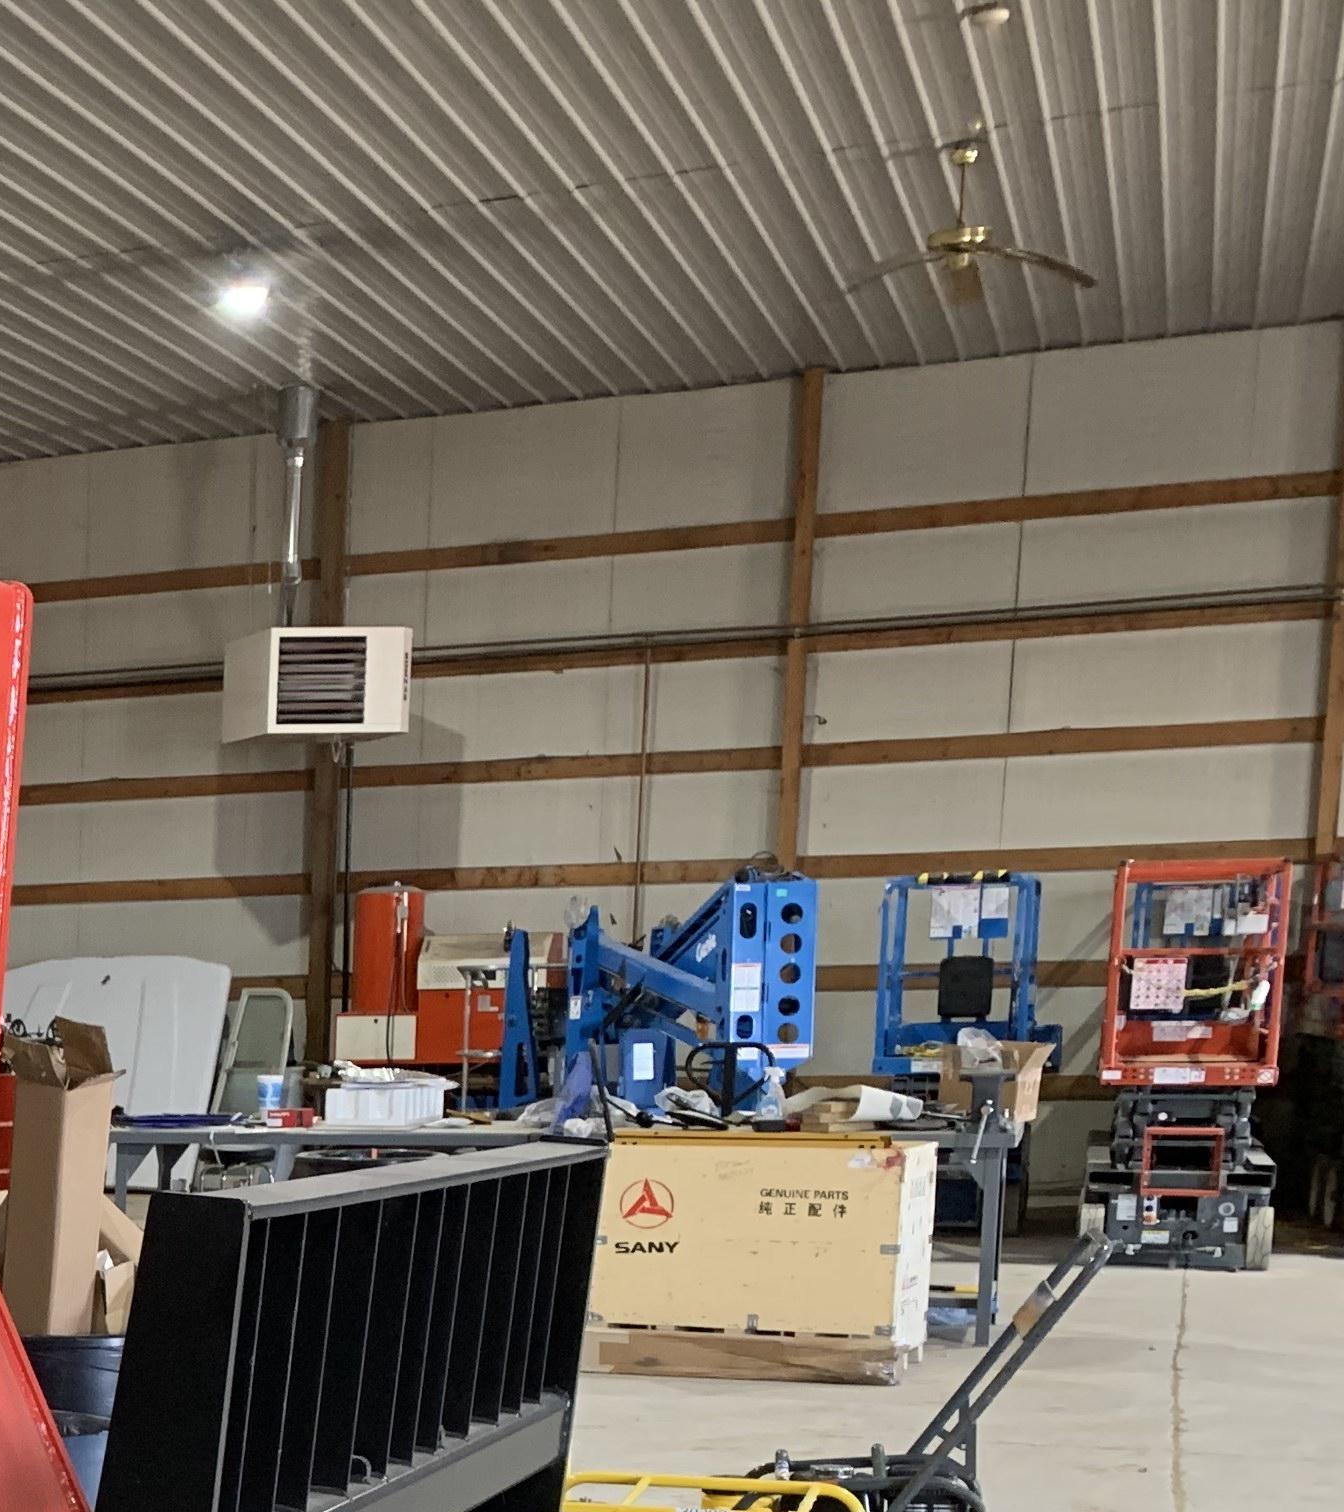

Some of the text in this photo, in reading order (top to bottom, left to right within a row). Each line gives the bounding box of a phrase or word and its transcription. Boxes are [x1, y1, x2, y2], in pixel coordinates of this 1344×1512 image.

[759, 1188, 849, 1201] GENUINE PARTS
[614, 1240, 680, 1254] SANY
